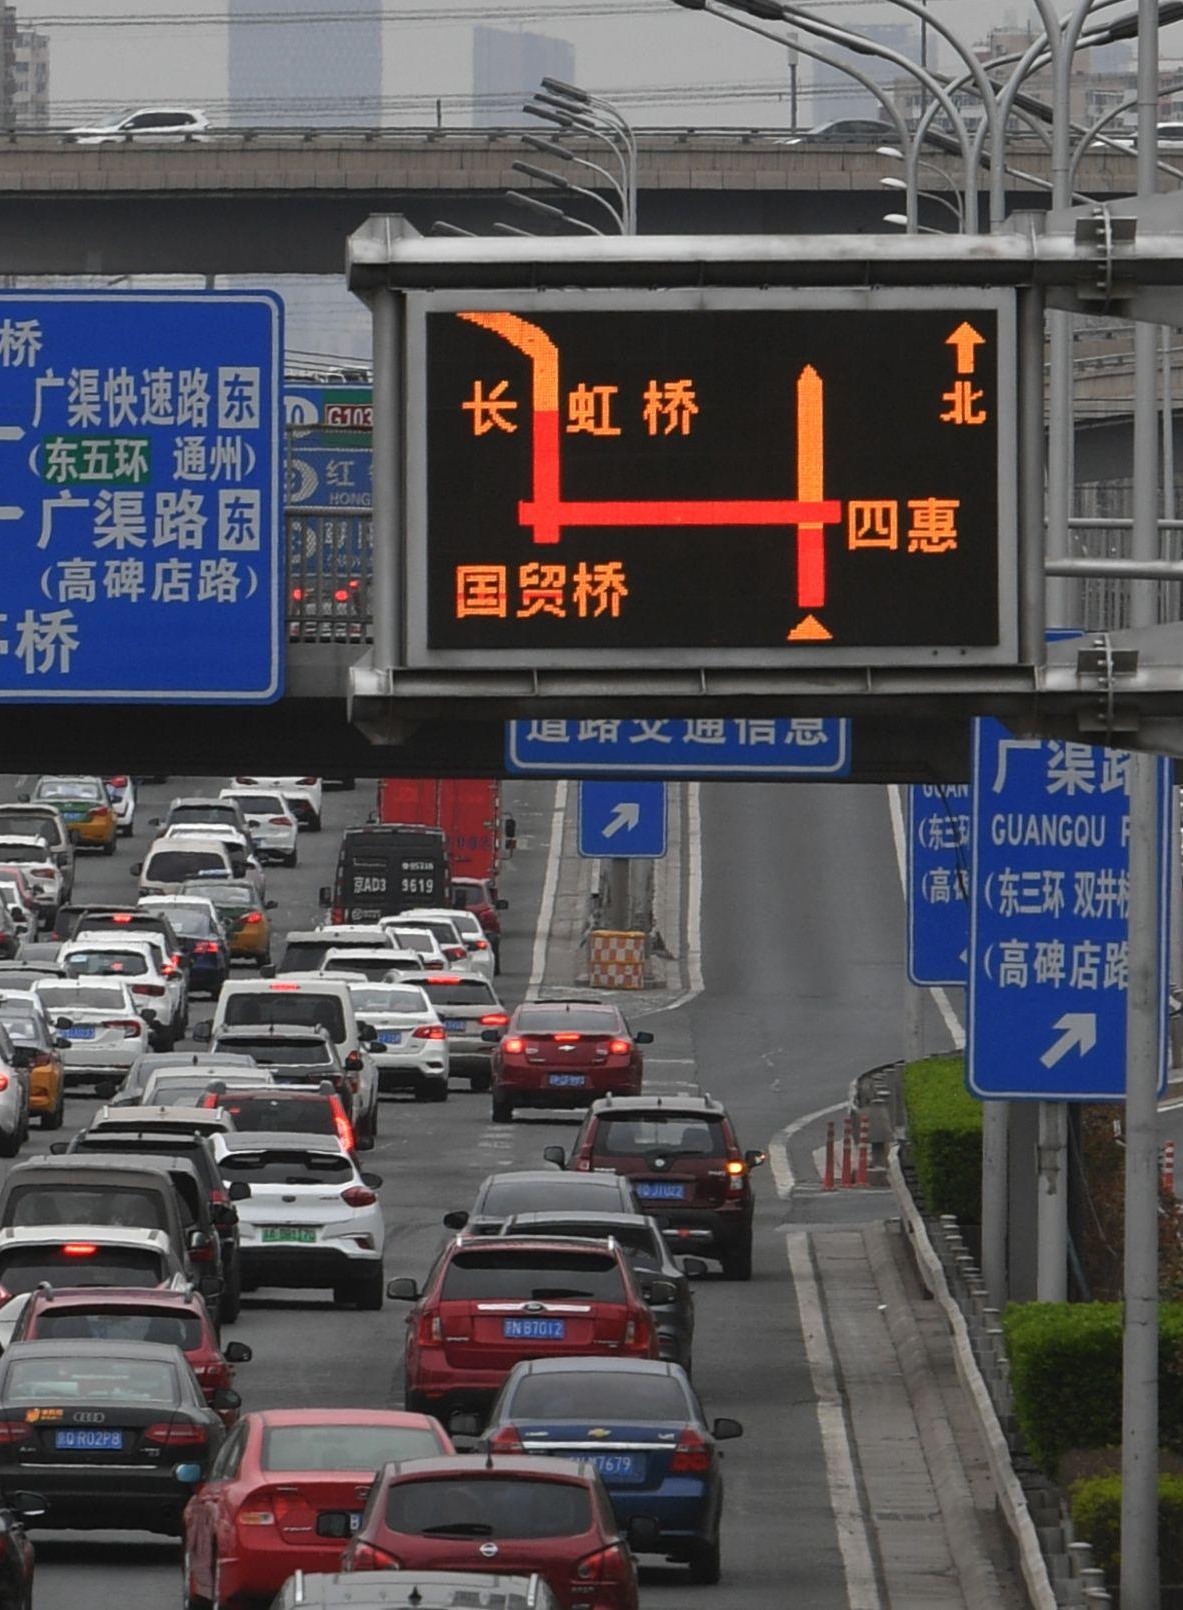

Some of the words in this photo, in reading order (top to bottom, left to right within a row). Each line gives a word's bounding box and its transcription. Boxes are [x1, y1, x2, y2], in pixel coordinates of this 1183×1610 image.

[32, 366, 211, 428] 广渠快速路
[224, 373, 255, 423] 东
[940, 381, 986, 424] 北
[36, 489, 208, 550] 广渠路
[224, 496, 255, 545] 东
[848, 497, 960, 553] 四惠
[41, 557, 258, 603] (高碑店路)
[457, 561, 628, 618] 国贸桥
[991, 814, 1106, 847] GUANGQU
[401, 878, 434, 894] 9619
